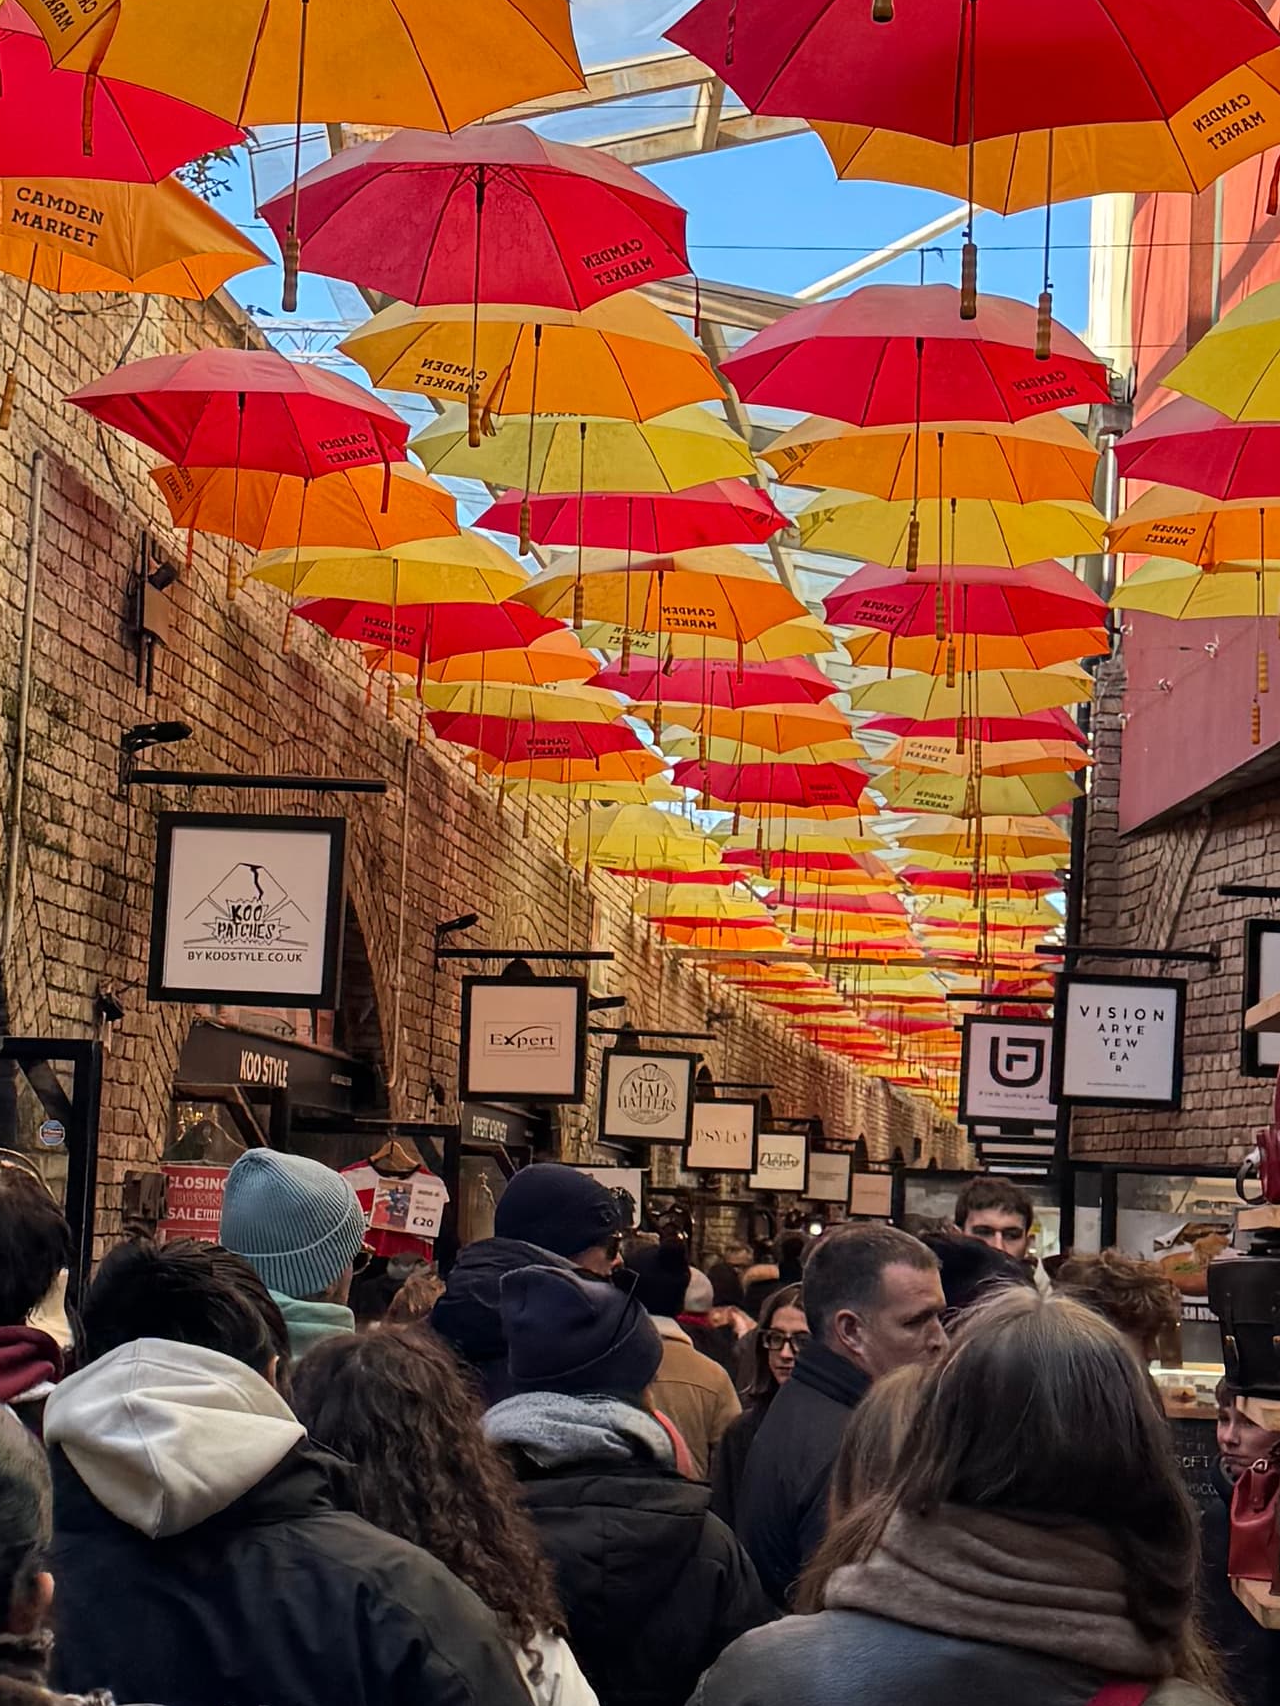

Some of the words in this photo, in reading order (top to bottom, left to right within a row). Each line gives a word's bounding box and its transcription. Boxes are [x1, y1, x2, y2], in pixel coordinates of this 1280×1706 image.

[16, 187, 104, 225] CAMDEN
[12, 209, 98, 247] MARKET
[231, 904, 263, 922] KOO
[217, 921, 276, 940] PATCHES
[187, 951, 203, 961] BY
[205, 951, 302, 963] KOOSTYLE.CO.UK
[1080, 1005, 1164, 1022] VISION
[490, 1025, 554, 1049] Expert
[1097, 1023, 1145, 1036] ARYE
[1102, 1037, 1138, 1049] YEW
[1109, 1051, 1130, 1062] EA
[240, 1050, 261, 1082] KOO
[262, 1054, 289, 1089] STYLE
[1115, 1064, 1122, 1073] R
[631, 1080, 668, 1097] MAD
[618, 1094, 677, 1113] HATTERS
[412, 1216, 434, 1228] £20
